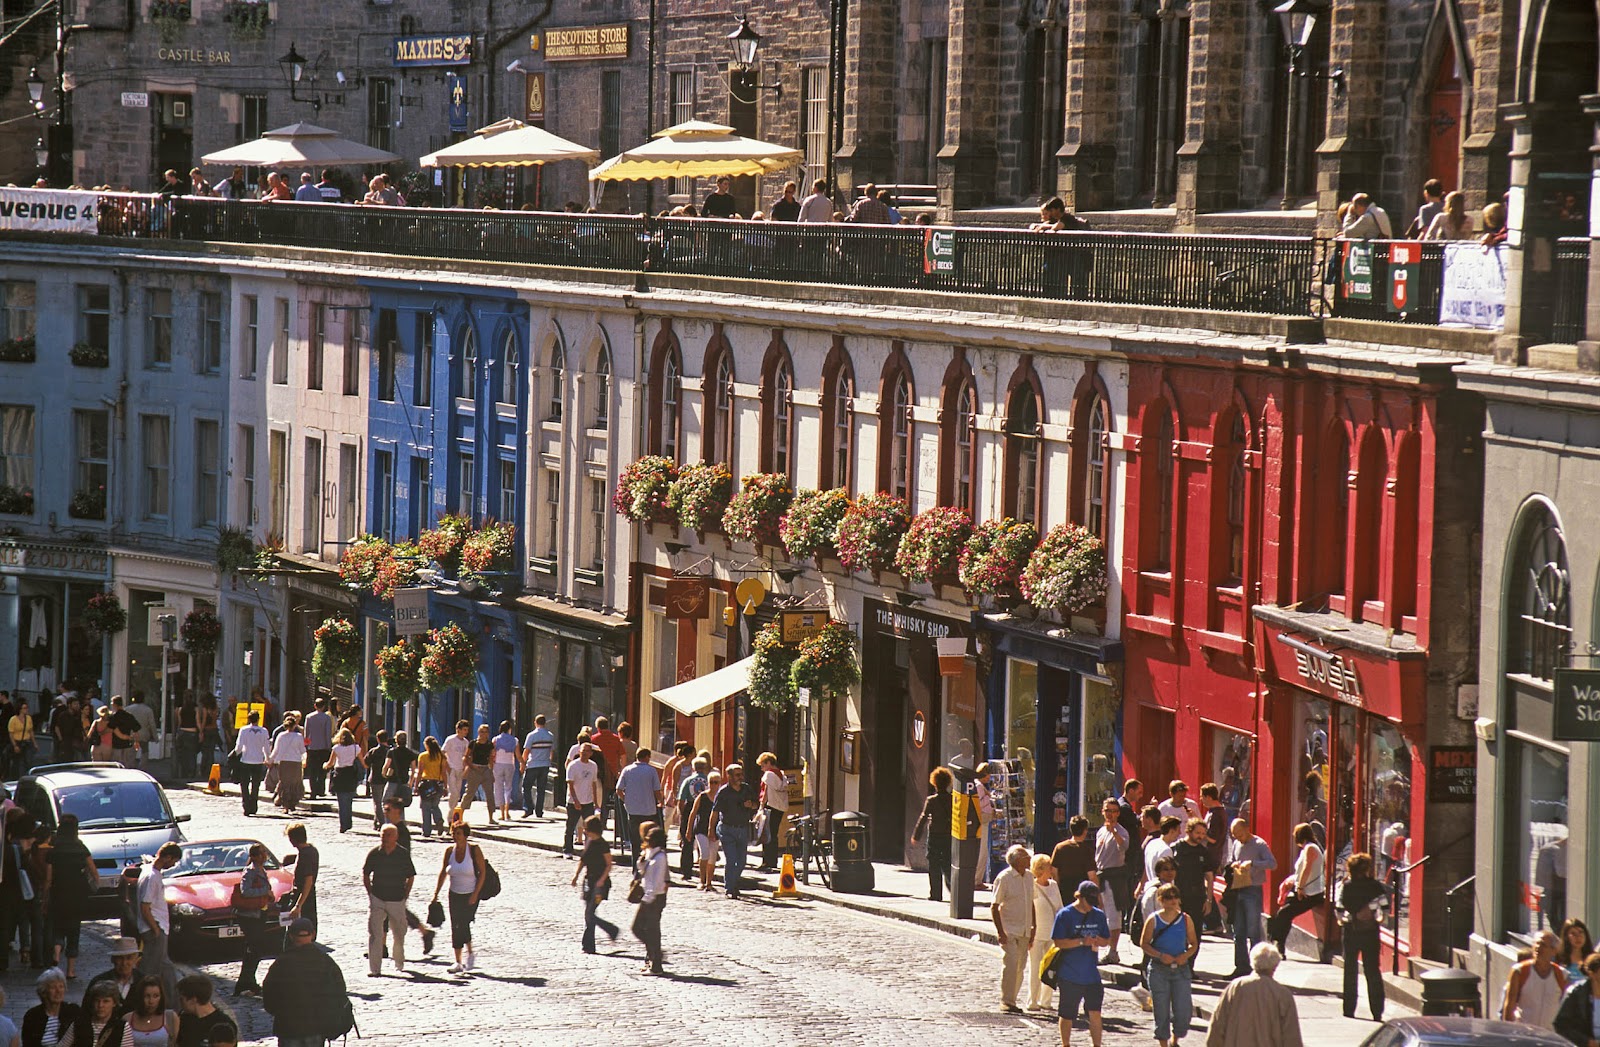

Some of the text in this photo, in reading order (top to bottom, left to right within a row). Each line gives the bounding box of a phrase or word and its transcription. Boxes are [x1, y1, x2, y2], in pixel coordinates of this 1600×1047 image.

[546, 27, 627, 46] THE SCOTTISH STORE
[158, 48, 231, 62] CASTLE BAR
[397, 37, 454, 60] MAXIES
[0, 201, 94, 220] venue 4
[40, 551, 68, 568] OLD
[70, 554, 107, 571] LACE
[876, 608, 950, 638] THE WHISKY SHOP
[914, 719, 924, 742] W
[966, 782, 974, 794] P
[1448, 786, 1470, 794] WINE
